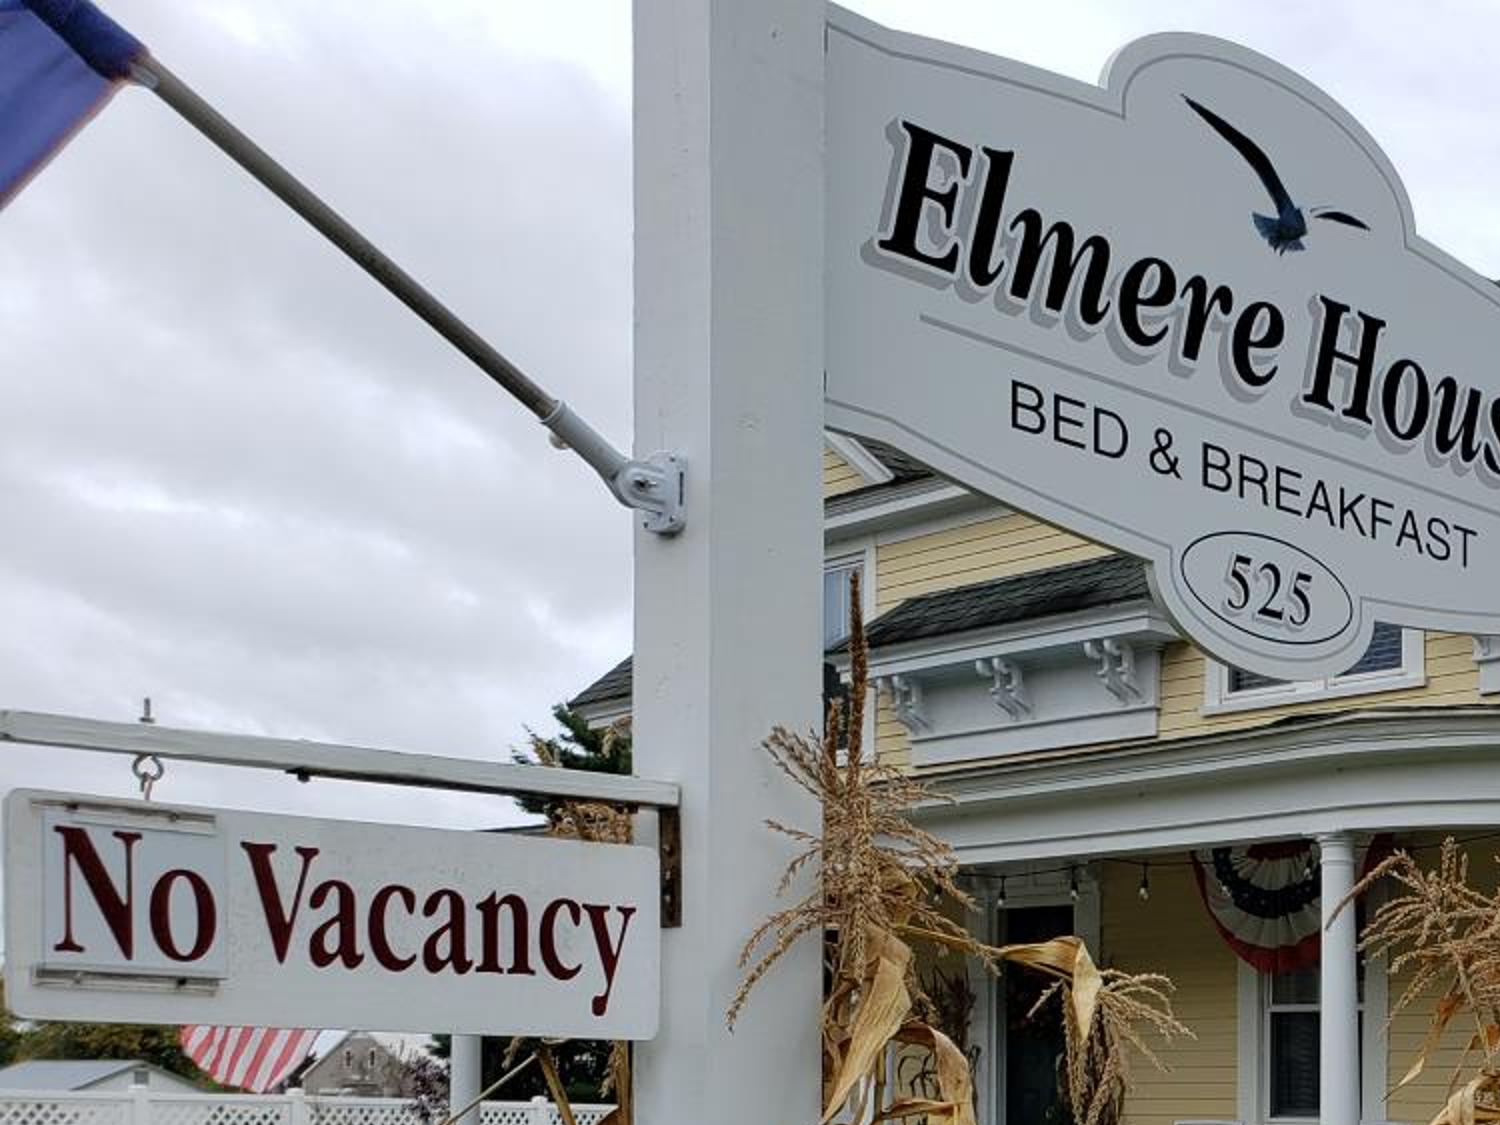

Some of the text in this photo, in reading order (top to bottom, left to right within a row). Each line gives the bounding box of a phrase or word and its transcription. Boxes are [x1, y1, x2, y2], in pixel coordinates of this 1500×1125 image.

[878, 119, 1286, 388] Elmere
[1010, 379, 1478, 569] BED & BREAKFAST
[1227, 552, 1313, 628] 525
[53, 825, 637, 1017] No Vacancy
